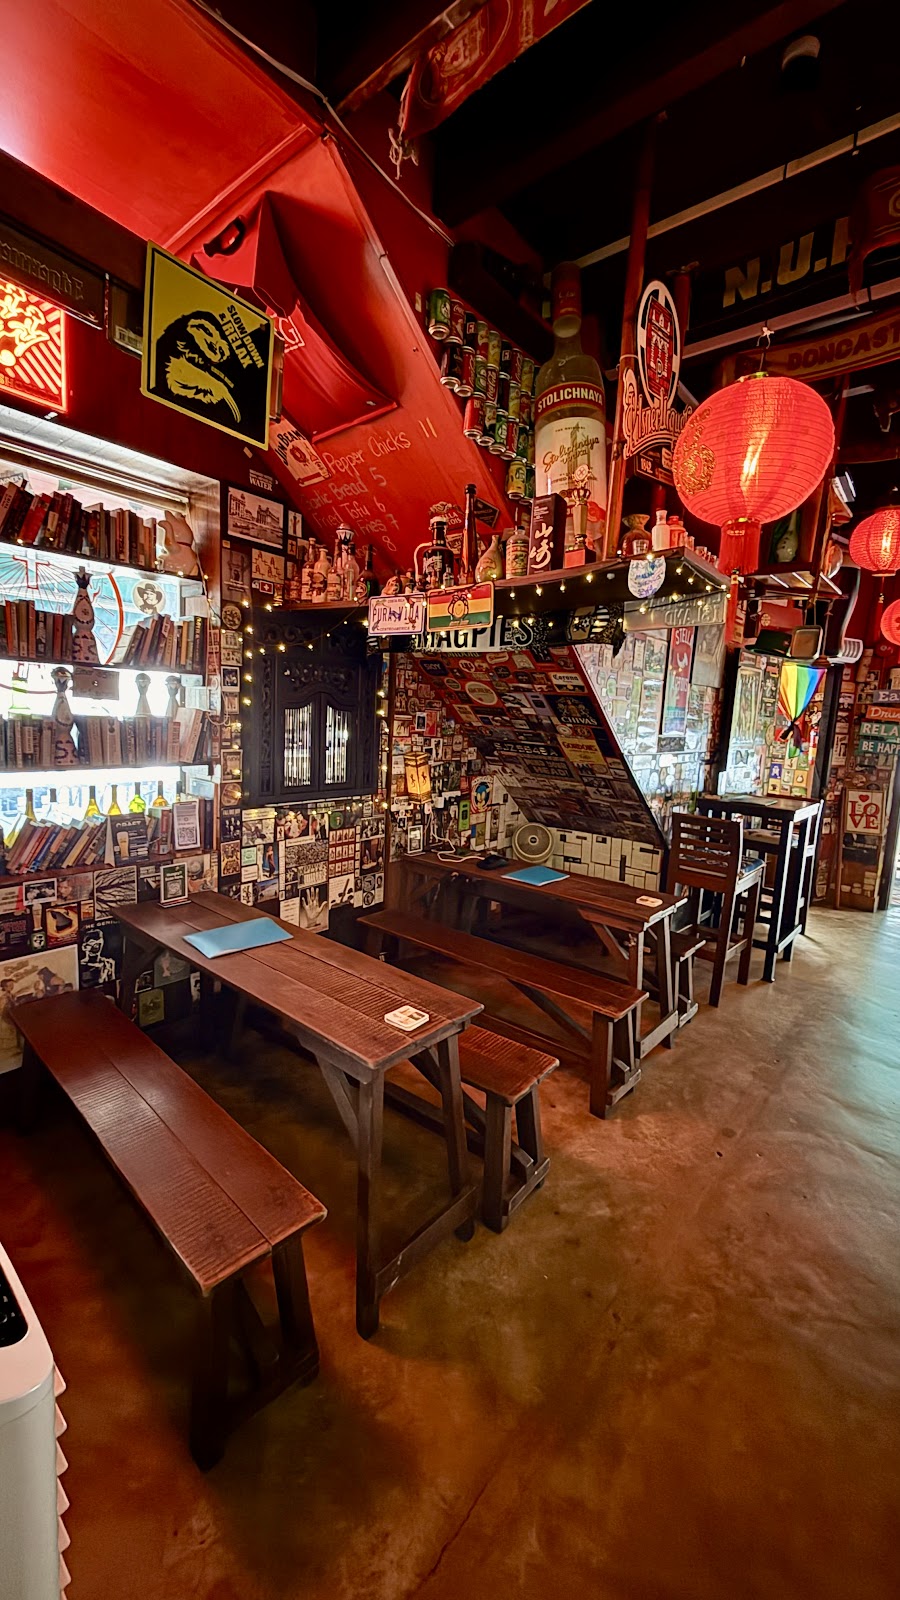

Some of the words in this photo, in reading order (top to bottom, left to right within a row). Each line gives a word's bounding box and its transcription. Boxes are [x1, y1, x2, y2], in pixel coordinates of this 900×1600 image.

[218, 312, 227, 322] &
[221, 320, 253, 369] RELAX
[227, 304, 248, 335] SLOW
[243, 335, 265, 369] DOWN
[537, 387, 604, 413] STOLICHNAYA
[277, 429, 307, 448] BEAM
[274, 441, 289, 466] JIM
[322, 450, 365, 478] Pepper
[368, 429, 412, 458] Chicks
[249, 476, 273, 492] WATER
[328, 473, 369, 500] Bread
[368, 466, 387, 487] 5
[312, 506, 344, 529] Fried
[339, 500, 371, 520] Tofu
[372, 607, 392, 622] PURA
[561, 716, 598, 726] CHIVAS
[862, 723, 899, 737] RELA
[861, 741, 875, 752] BE
